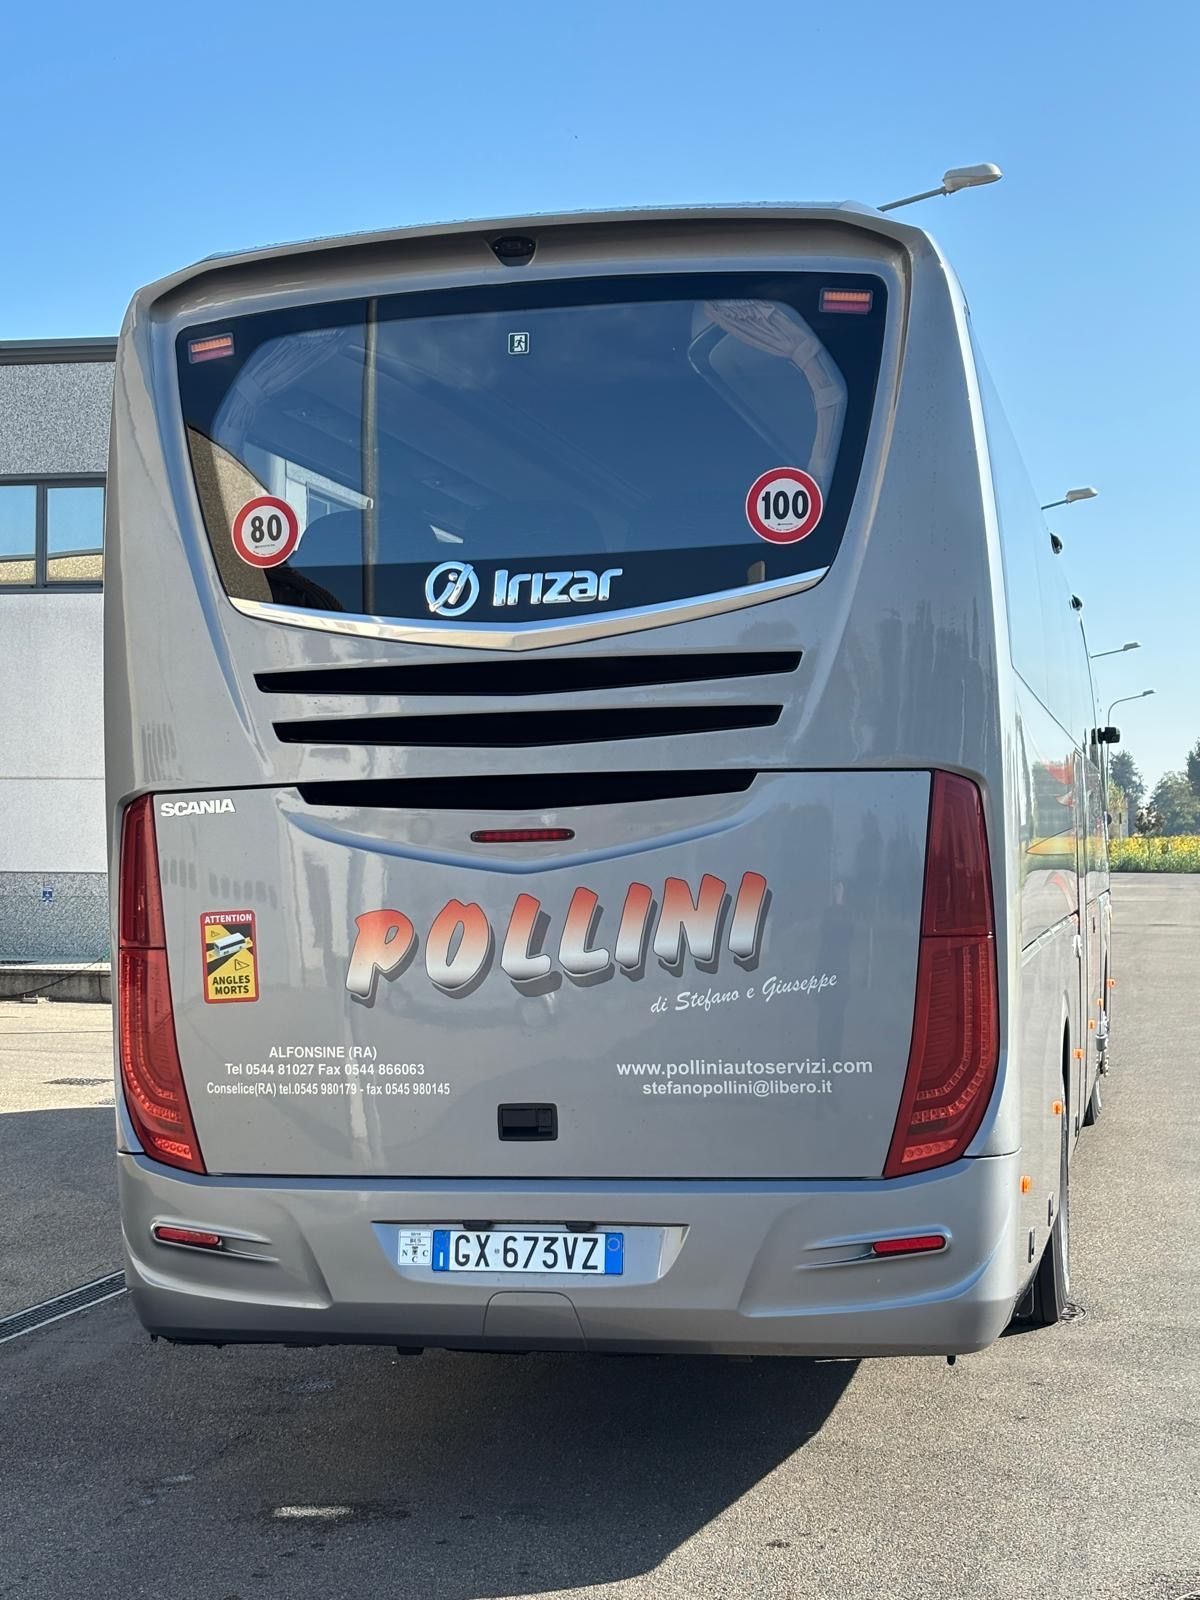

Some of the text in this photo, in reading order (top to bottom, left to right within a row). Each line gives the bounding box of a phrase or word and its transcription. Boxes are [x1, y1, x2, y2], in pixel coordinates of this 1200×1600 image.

[762, 489, 809, 520] 100
[250, 513, 283, 543] 80
[492, 568, 624, 607] Irizar
[160, 798, 236, 817] SCANIA
[204, 913, 253, 924] ATTENTION
[345, 871, 770, 1004] POLLINI
[212, 975, 251, 986] ANGLES
[214, 985, 250, 996] MORTS
[650, 973, 838, 1014] di Stefano e Giuseppe
[269, 1046, 378, 1060] ALFONSINE (RA)
[224, 1063, 425, 1075] Tel 0544 81027 Fax 0544 866063
[616, 1058, 873, 1078] www.polliniautoservizi.com
[206, 1081, 277, 1097] Conselice(RA)
[320, 1082, 357, 1095] 980179
[366, 1082, 383, 1095] fax
[385, 1082, 410, 1095] 0545
[412, 1082, 450, 1095] 980145
[642, 1080, 833, 1097] stefanopollini@libero.it
